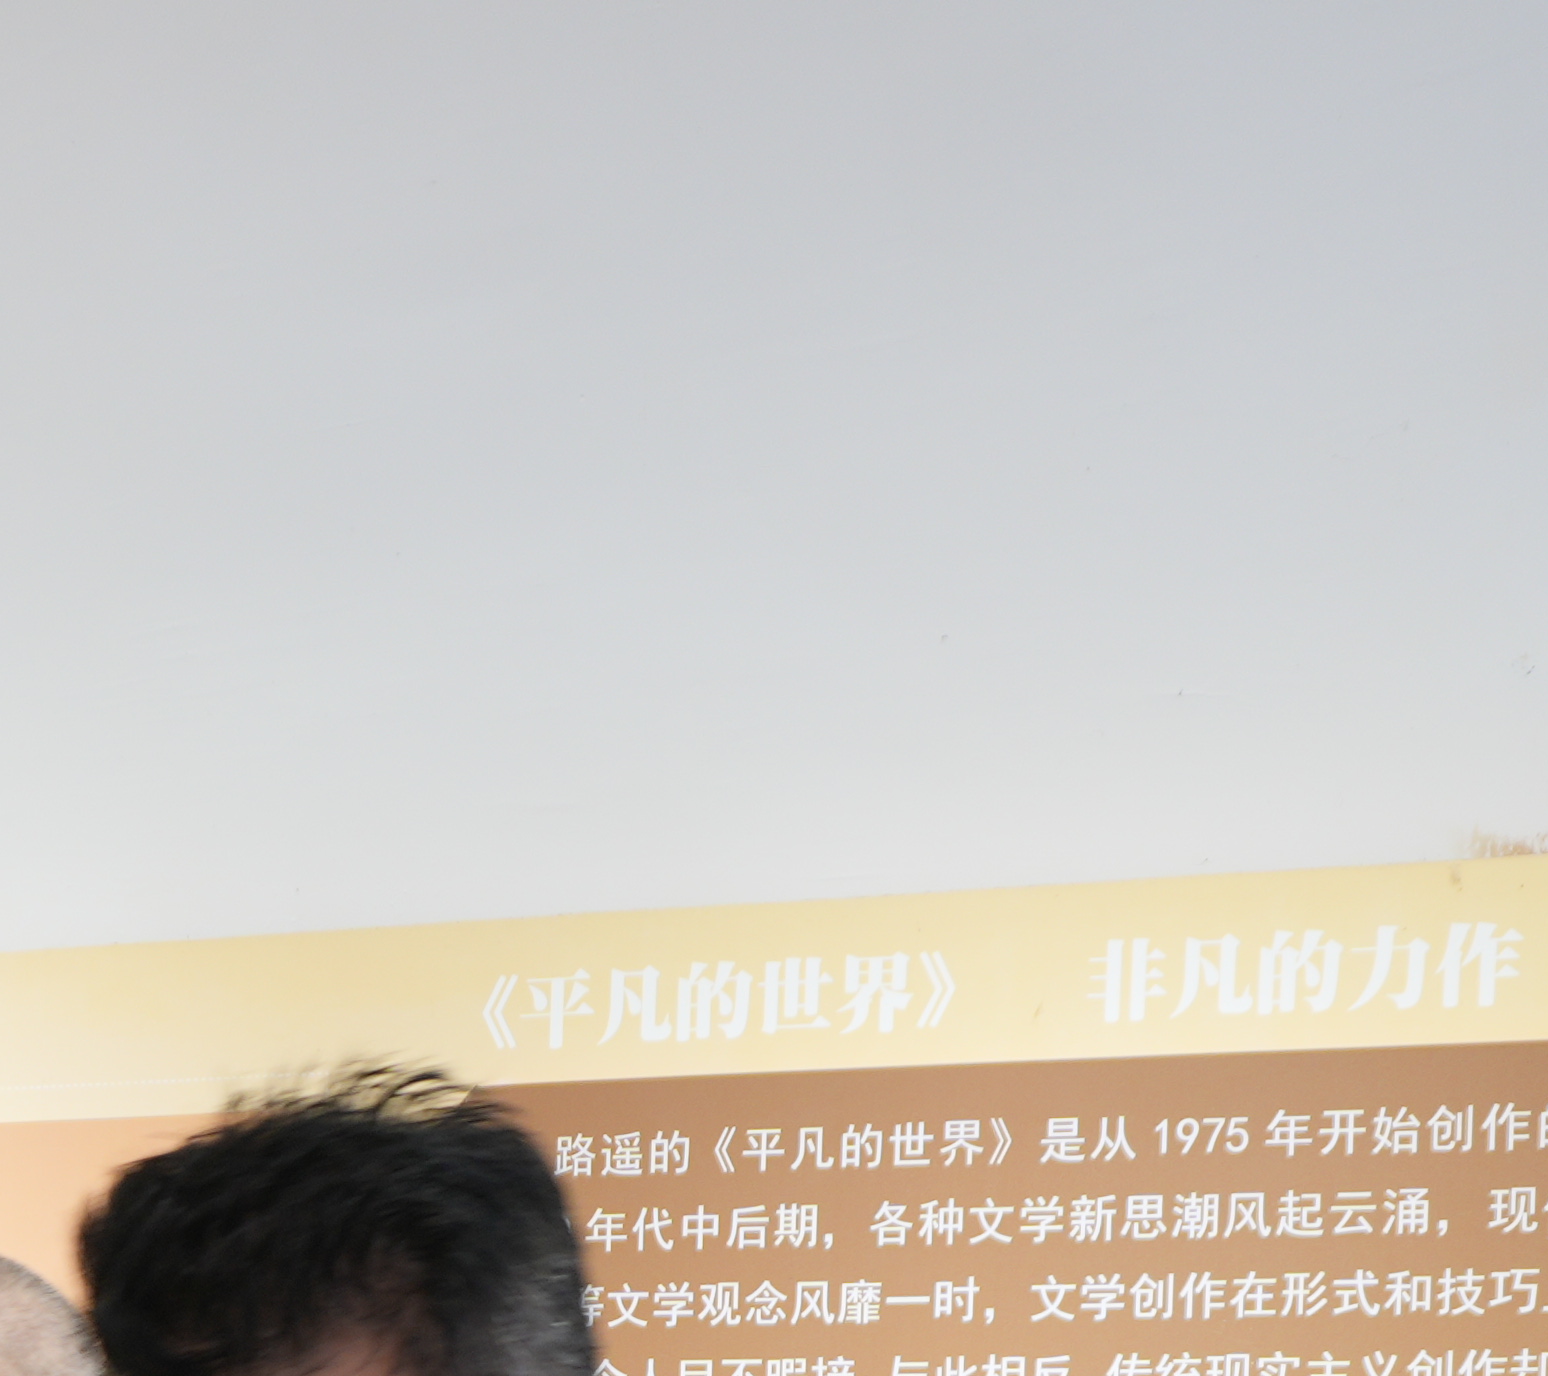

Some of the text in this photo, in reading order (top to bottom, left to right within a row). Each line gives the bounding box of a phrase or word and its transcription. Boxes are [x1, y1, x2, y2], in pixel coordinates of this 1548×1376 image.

[479, 920, 1521, 1052] 《平凡的世界》 非凡的力作
